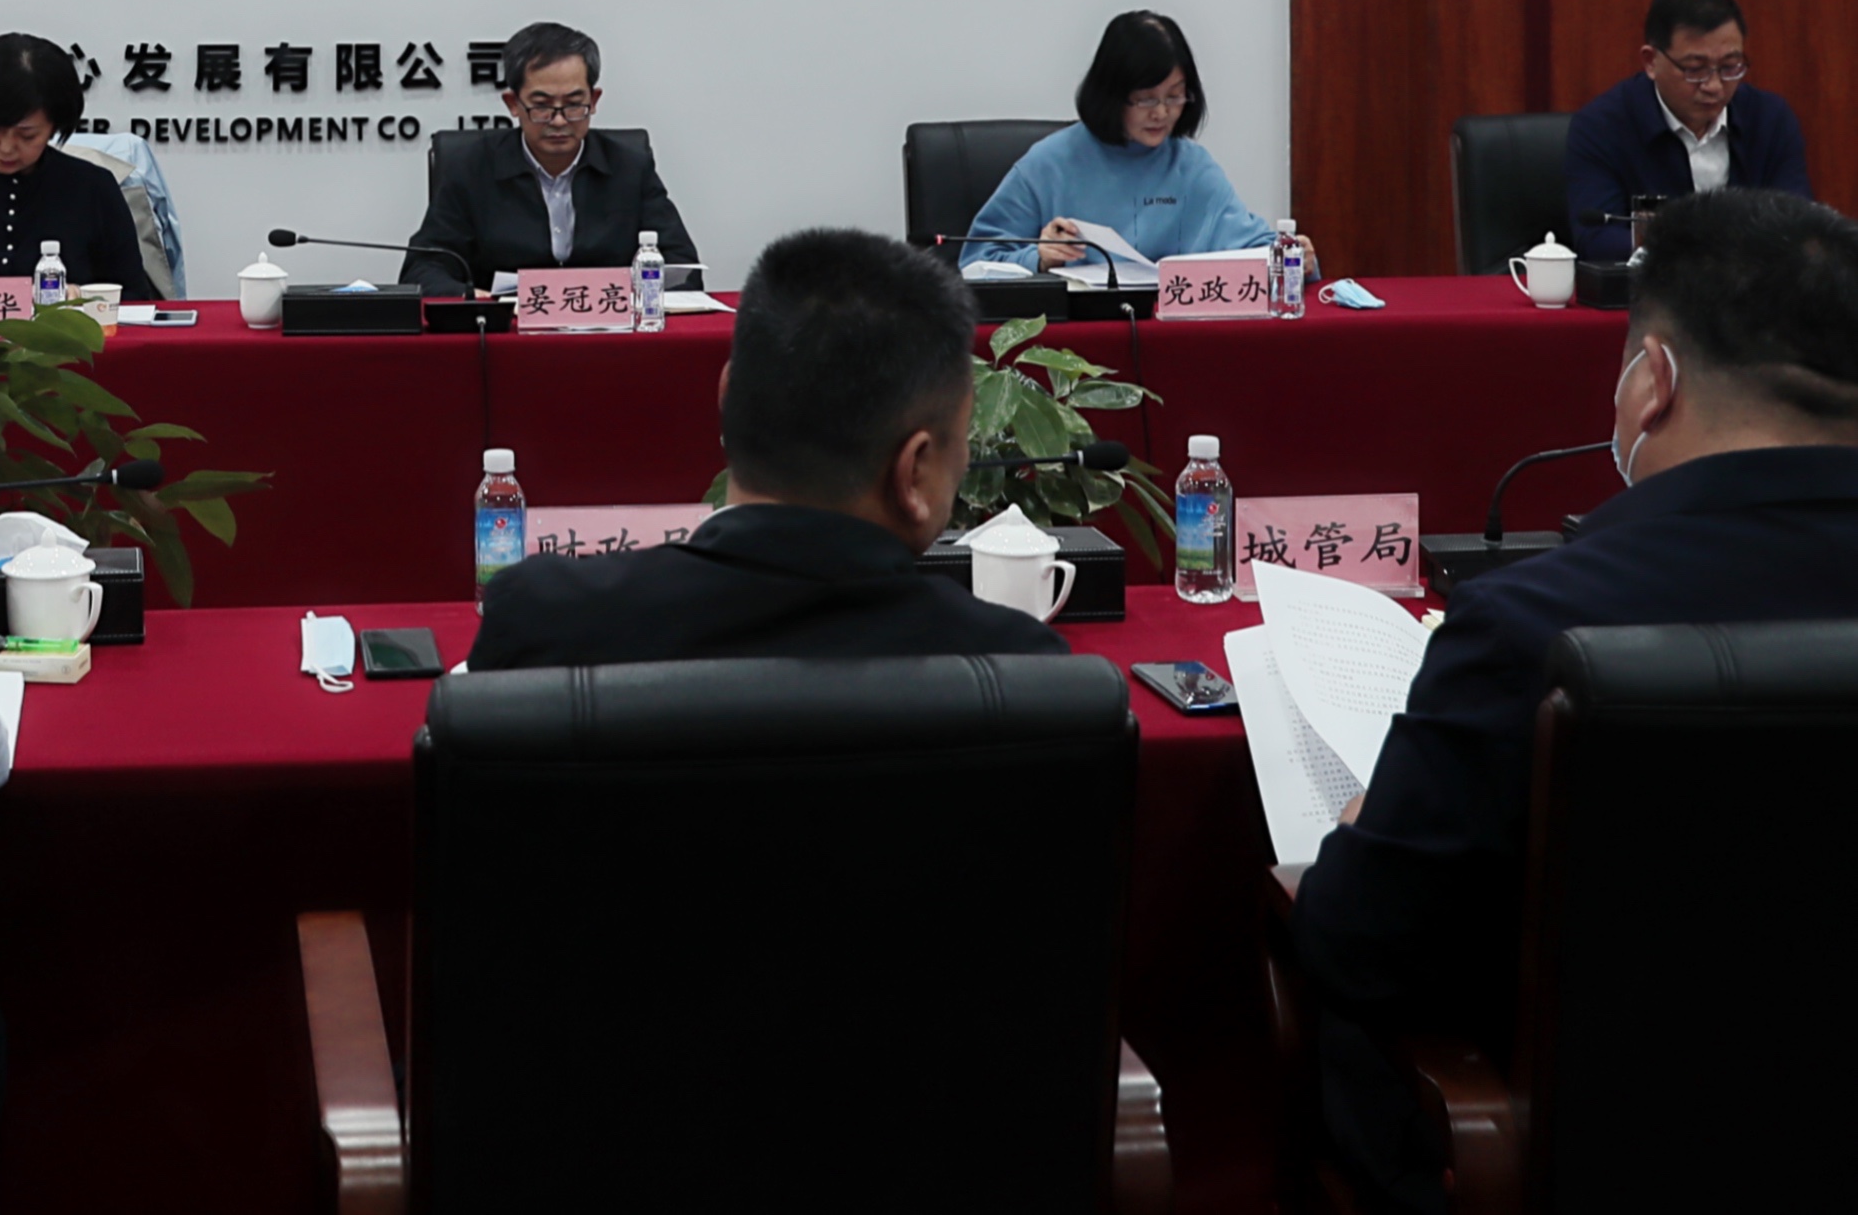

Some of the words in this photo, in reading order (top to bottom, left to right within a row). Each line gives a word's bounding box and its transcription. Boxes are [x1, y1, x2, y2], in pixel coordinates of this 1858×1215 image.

[130, 117, 370, 144] DEVELOPMENT
[520, 283, 629, 315] 晏冠亮
[1164, 275, 1267, 306] 党政办
[1239, 521, 1413, 571] 城管局
